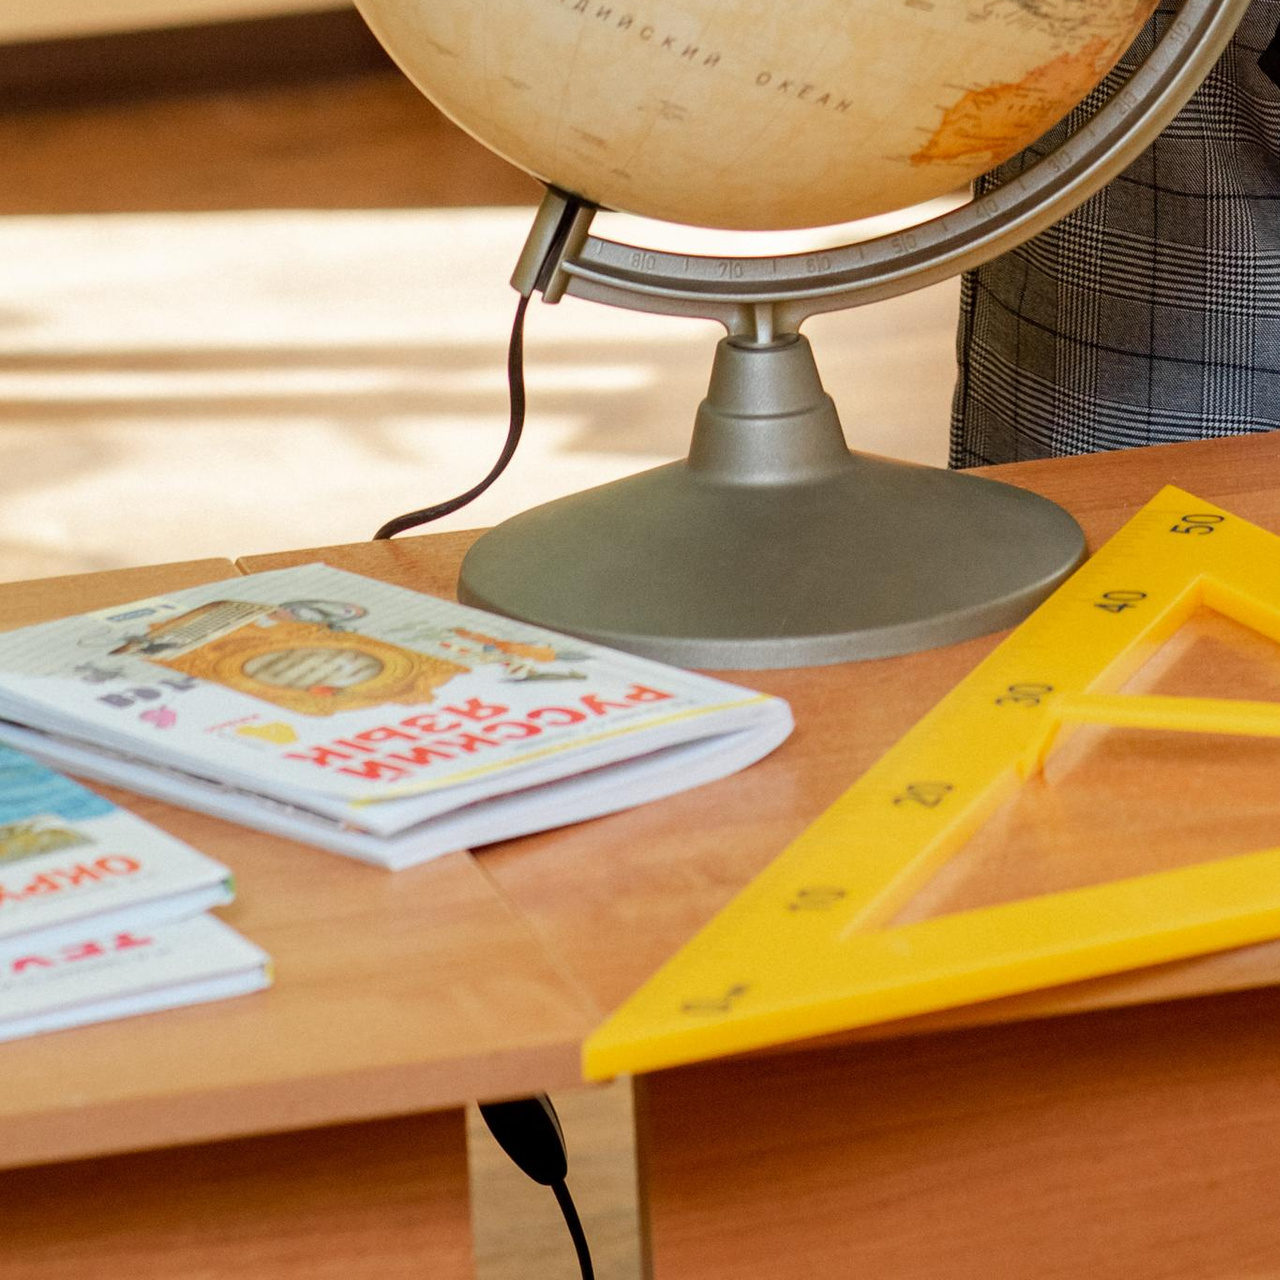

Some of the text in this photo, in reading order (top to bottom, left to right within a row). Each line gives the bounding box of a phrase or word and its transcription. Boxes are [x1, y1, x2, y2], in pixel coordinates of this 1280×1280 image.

[754, 69, 854, 114] ОКЕАН
[1169, 514, 1226, 536] 50
[1094, 590, 1148, 615] 40
[285, 696, 510, 770] ЯЗЫК
[335, 682, 676, 784] РУССКИЙ
